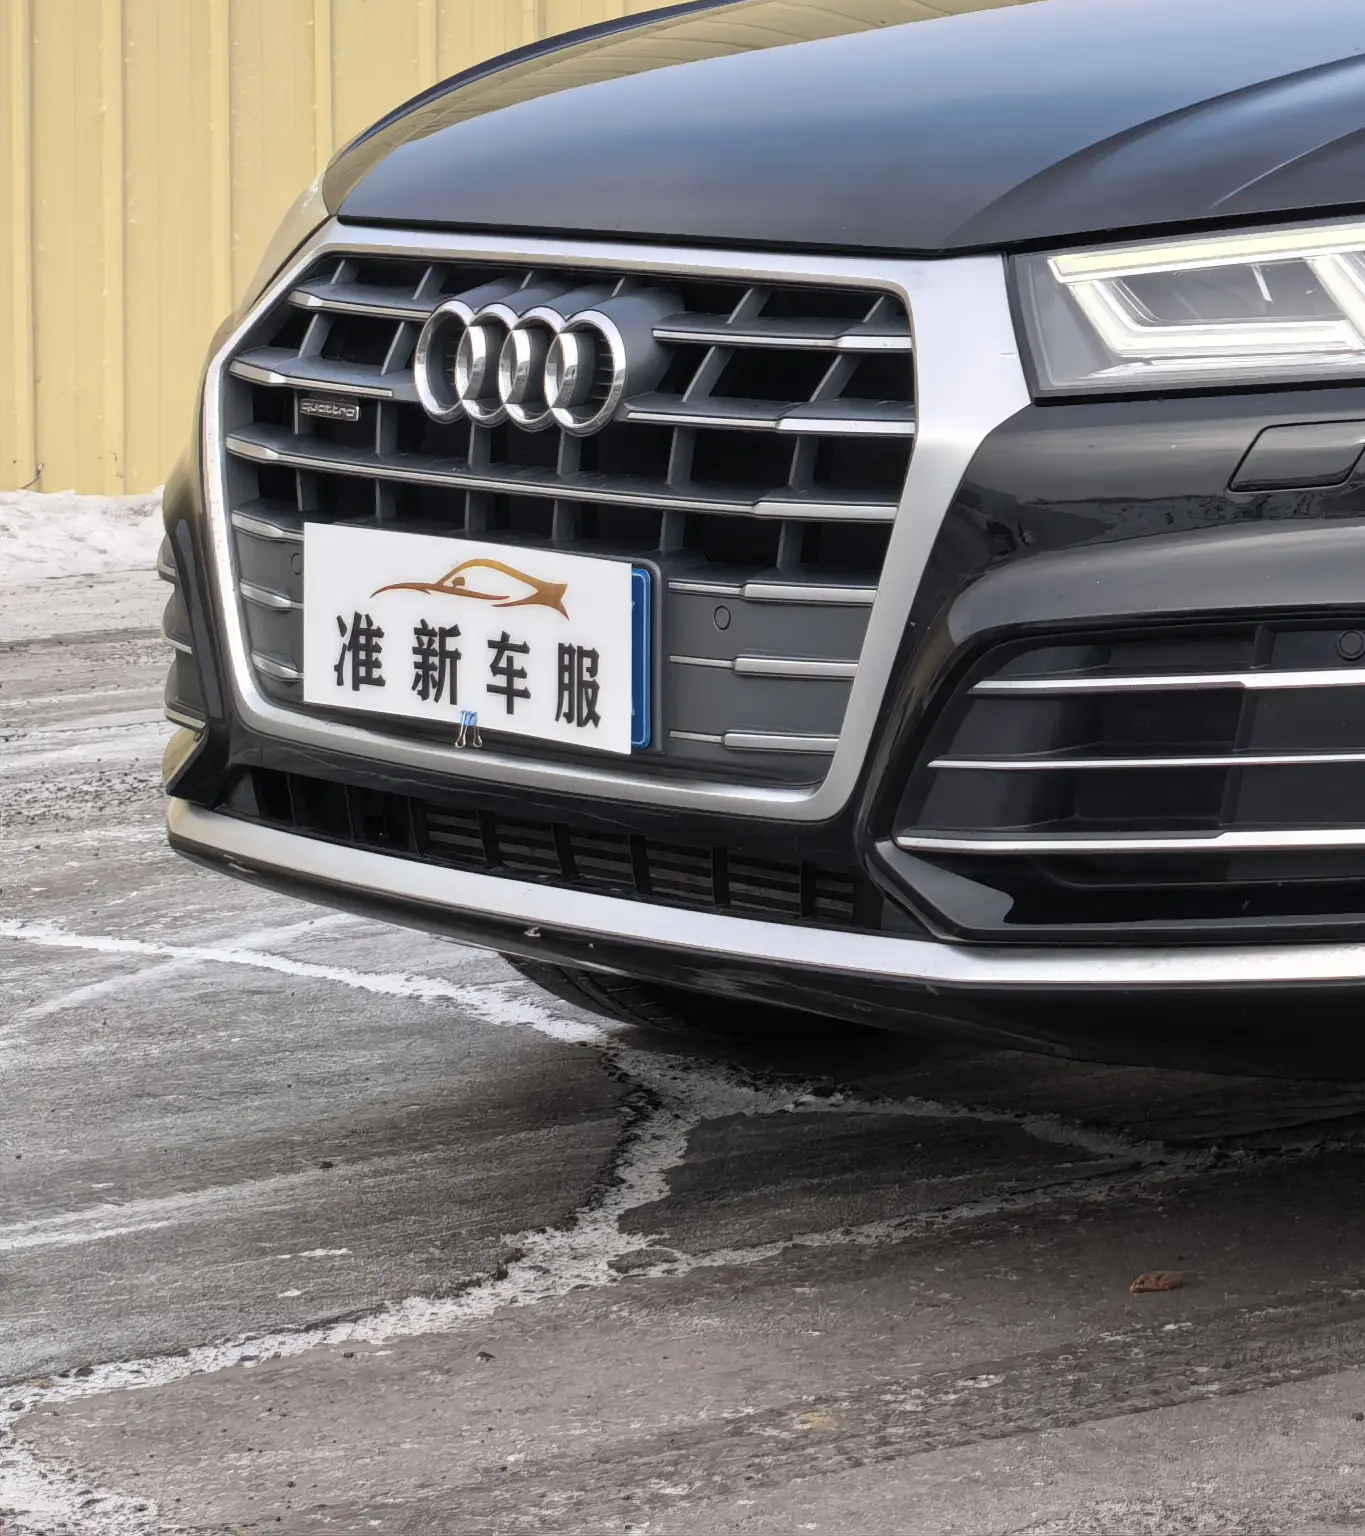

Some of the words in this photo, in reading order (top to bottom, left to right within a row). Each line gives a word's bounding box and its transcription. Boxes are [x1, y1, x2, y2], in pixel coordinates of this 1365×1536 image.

[301, 402, 355, 417] quattro
[334, 611, 602, 728] 准新车服
